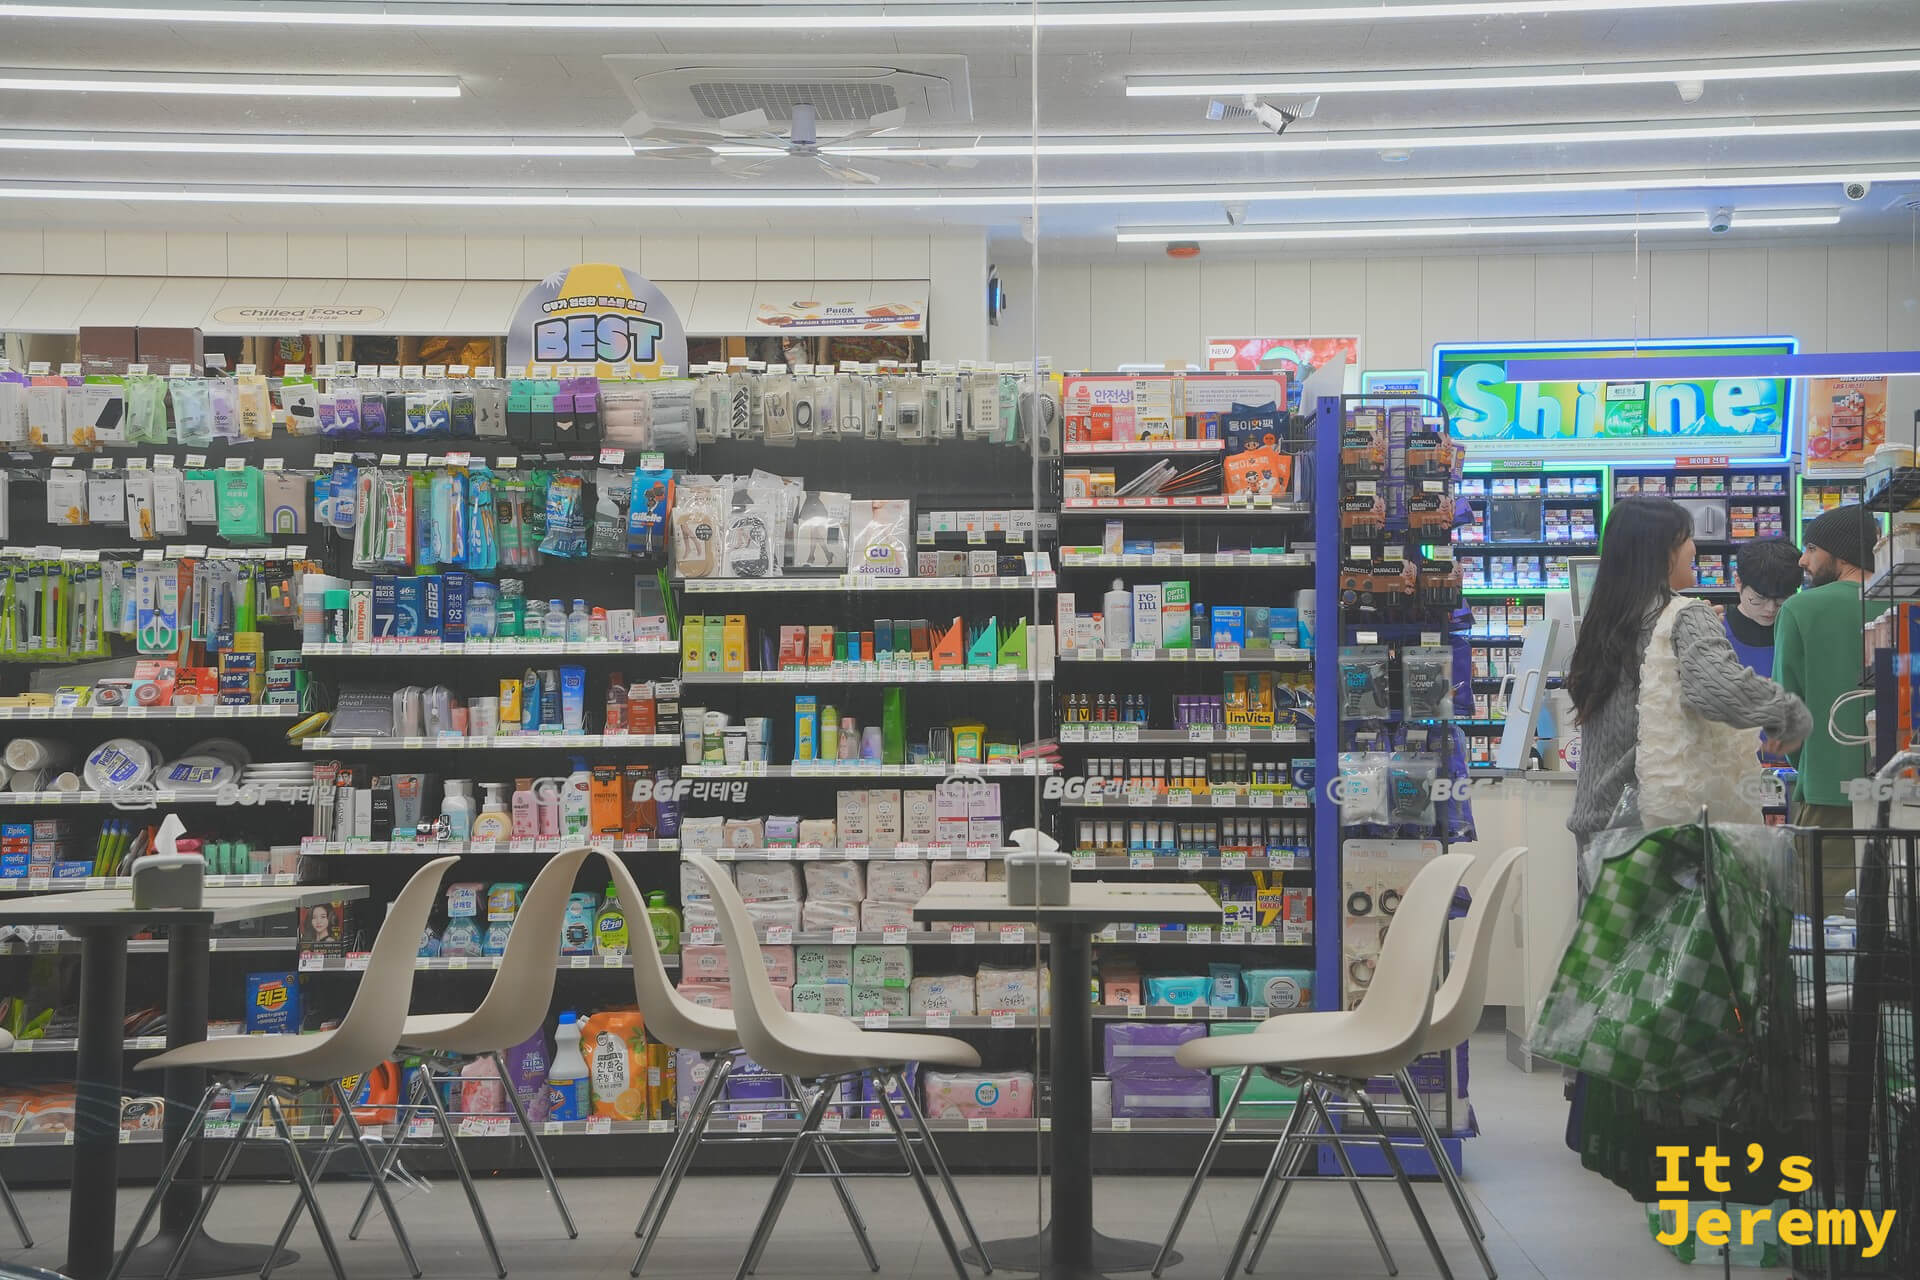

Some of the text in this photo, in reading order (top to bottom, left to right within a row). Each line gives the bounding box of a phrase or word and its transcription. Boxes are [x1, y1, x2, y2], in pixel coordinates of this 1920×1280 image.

[239, 308, 363, 317] Chilled Food
[534, 313, 663, 363] BEST
[1211, 347, 1231, 355] NEW
[870, 547, 889, 558] CU
[859, 564, 901, 575] Stocking
[974, 563, 996, 574] 0.01
[375, 590, 395, 598] 페리오
[1167, 594, 1185, 602] FREE
[428, 582, 439, 619] 2080
[1138, 601, 1157, 610] nu
[375, 614, 395, 638] 7
[1410, 680, 1435, 688] Cover
[1230, 712, 1272, 723] ImVita
[631, 778, 749, 804] BGF리테일
[8, 827, 27, 836] Ziploc
[4, 867, 24, 877] Ziploc
[600, 919, 622, 931] 참그린
[256, 987, 288, 1007] 테크
